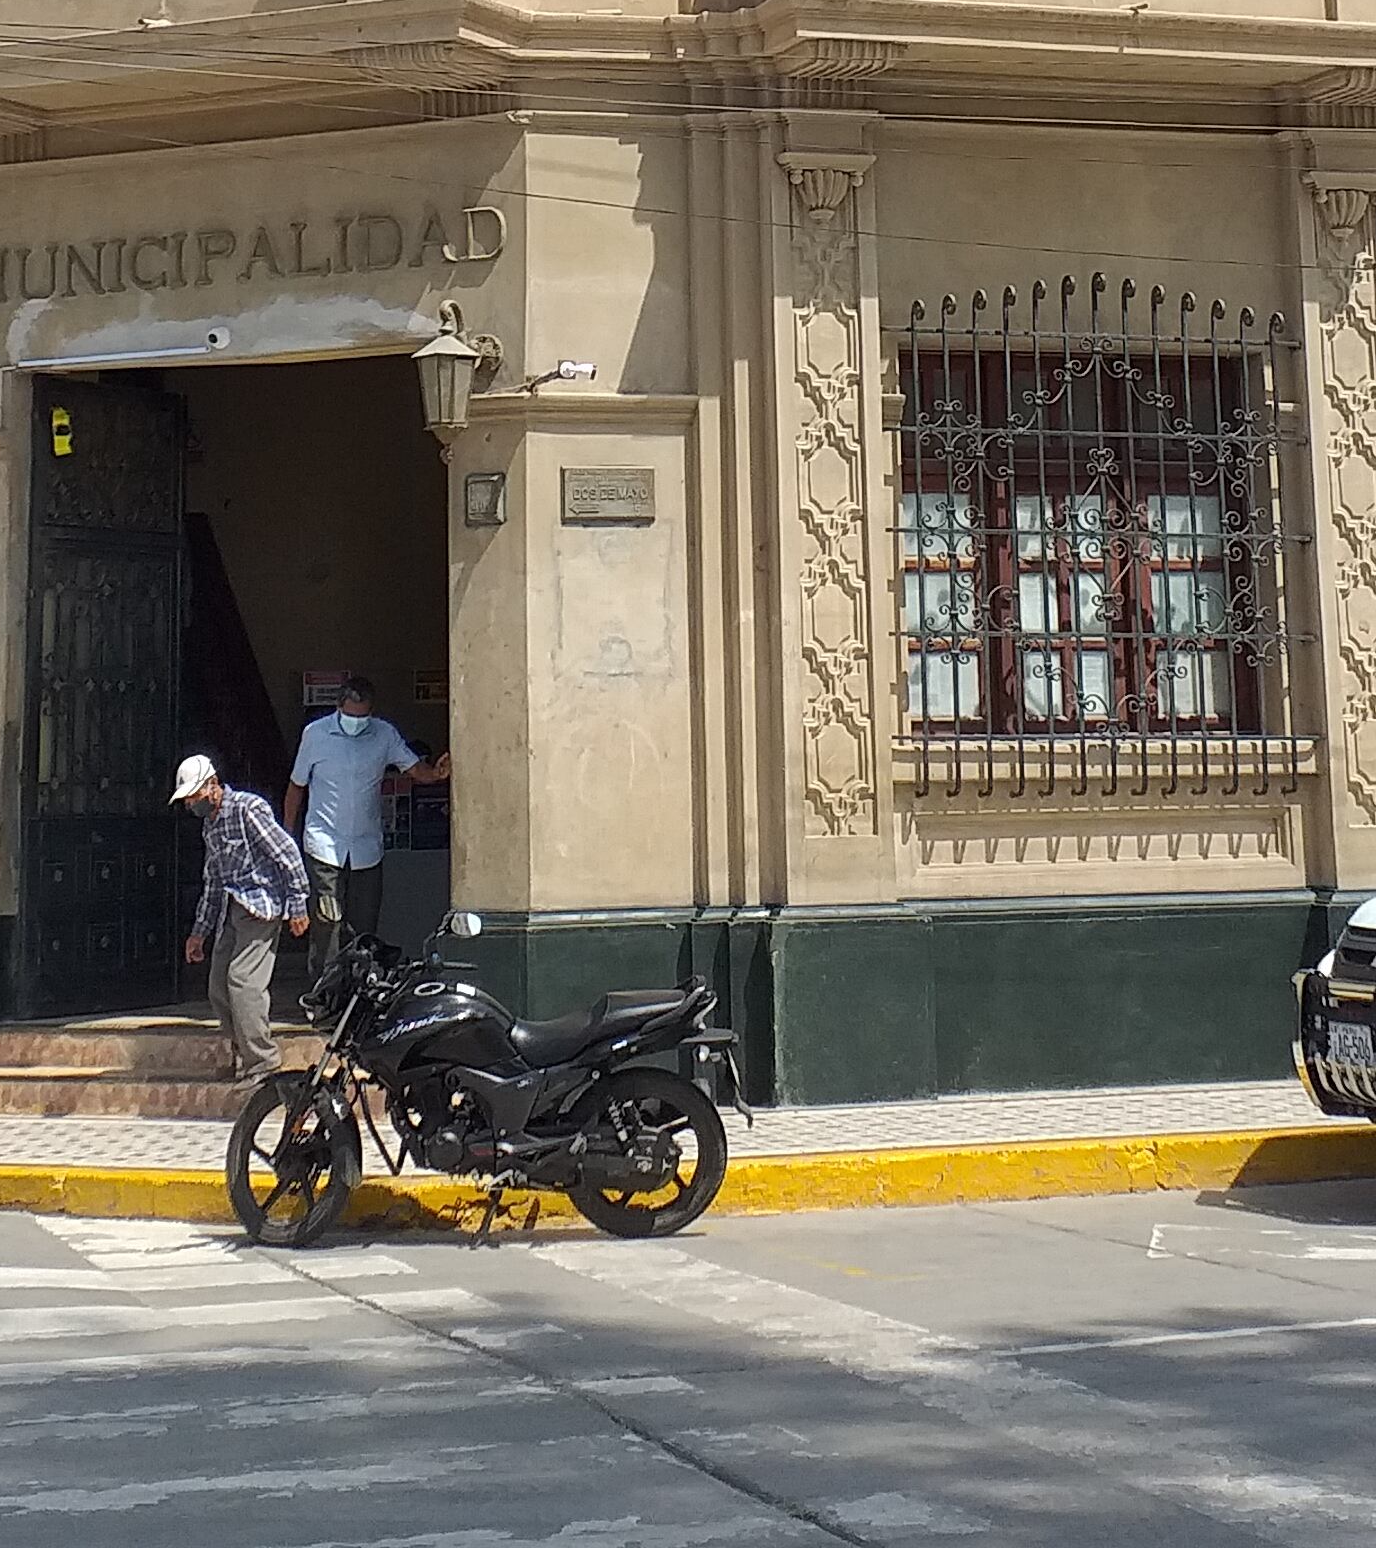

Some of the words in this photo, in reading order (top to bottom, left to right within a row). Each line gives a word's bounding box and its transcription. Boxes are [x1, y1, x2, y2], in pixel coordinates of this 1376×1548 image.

[572, 487, 596, 500] DOS
[600, 487, 616, 500] DE
[617, 487, 648, 500] MAYO
